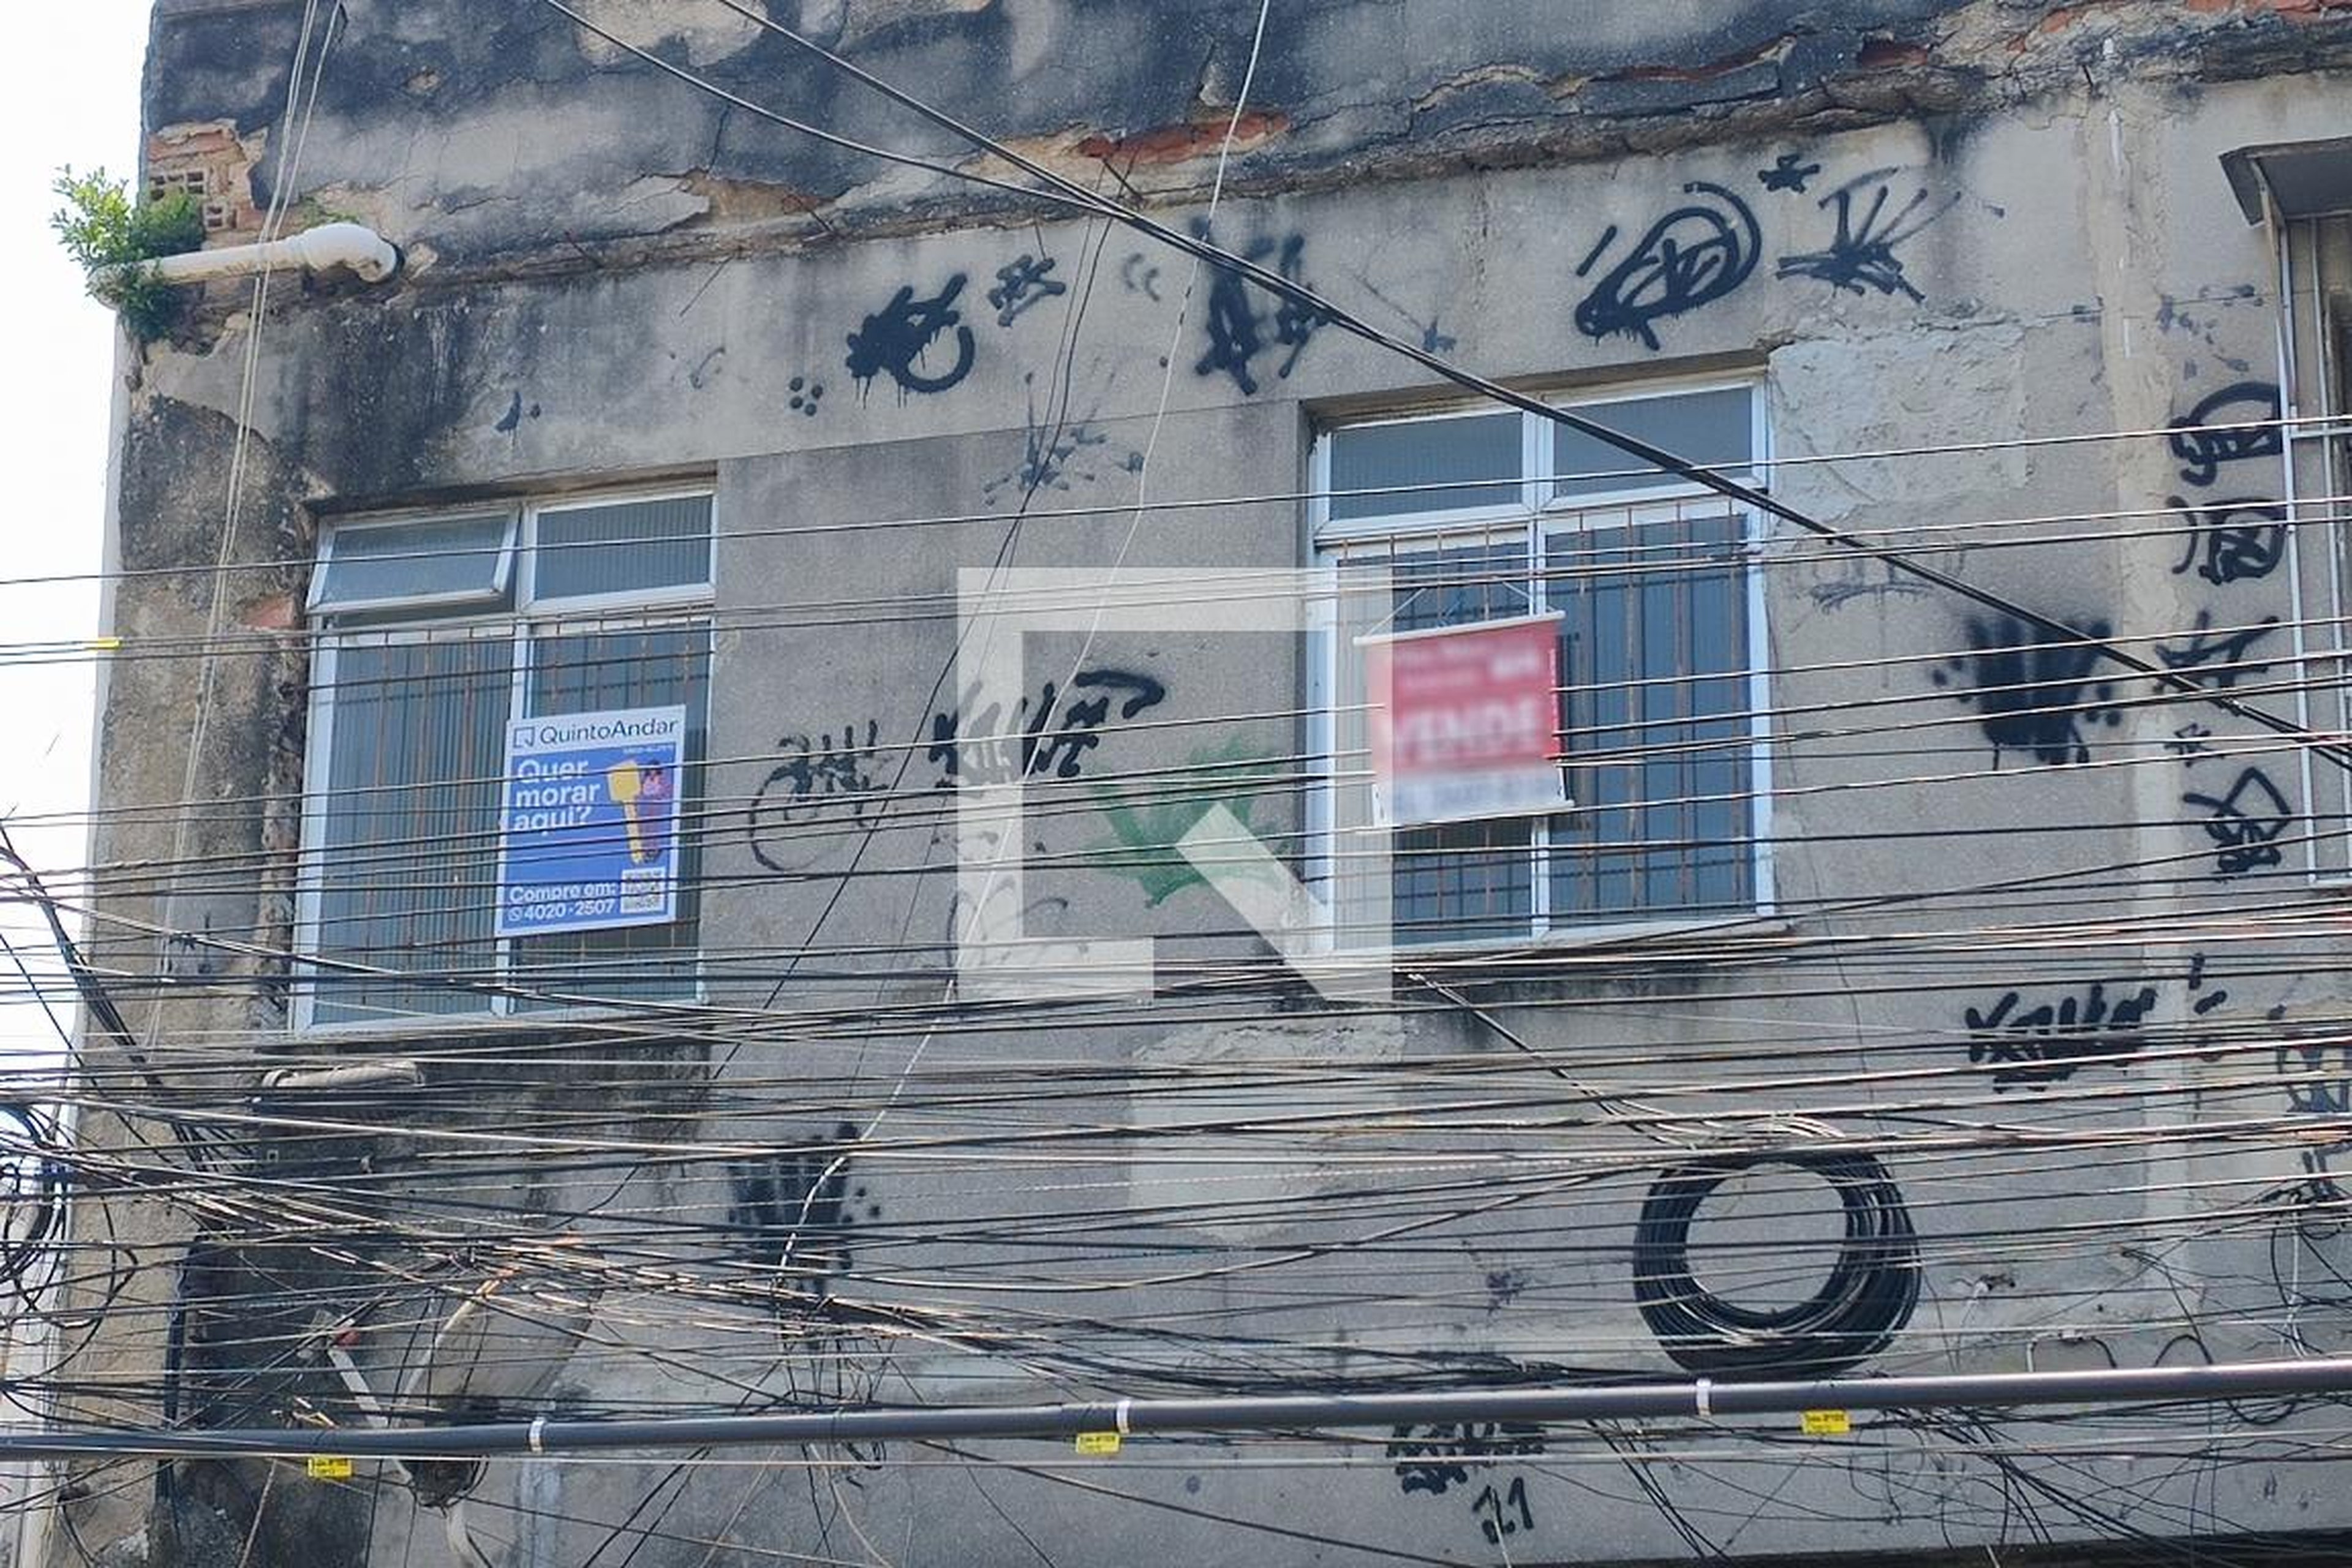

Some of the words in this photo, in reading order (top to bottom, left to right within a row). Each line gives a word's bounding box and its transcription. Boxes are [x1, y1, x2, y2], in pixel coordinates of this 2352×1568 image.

[540, 718, 677, 745] QuintoAndar
[518, 759, 589, 783] Quer
[516, 783, 601, 807] morar
[513, 805, 591, 836] aqui?
[510, 886, 581, 904] Compre
